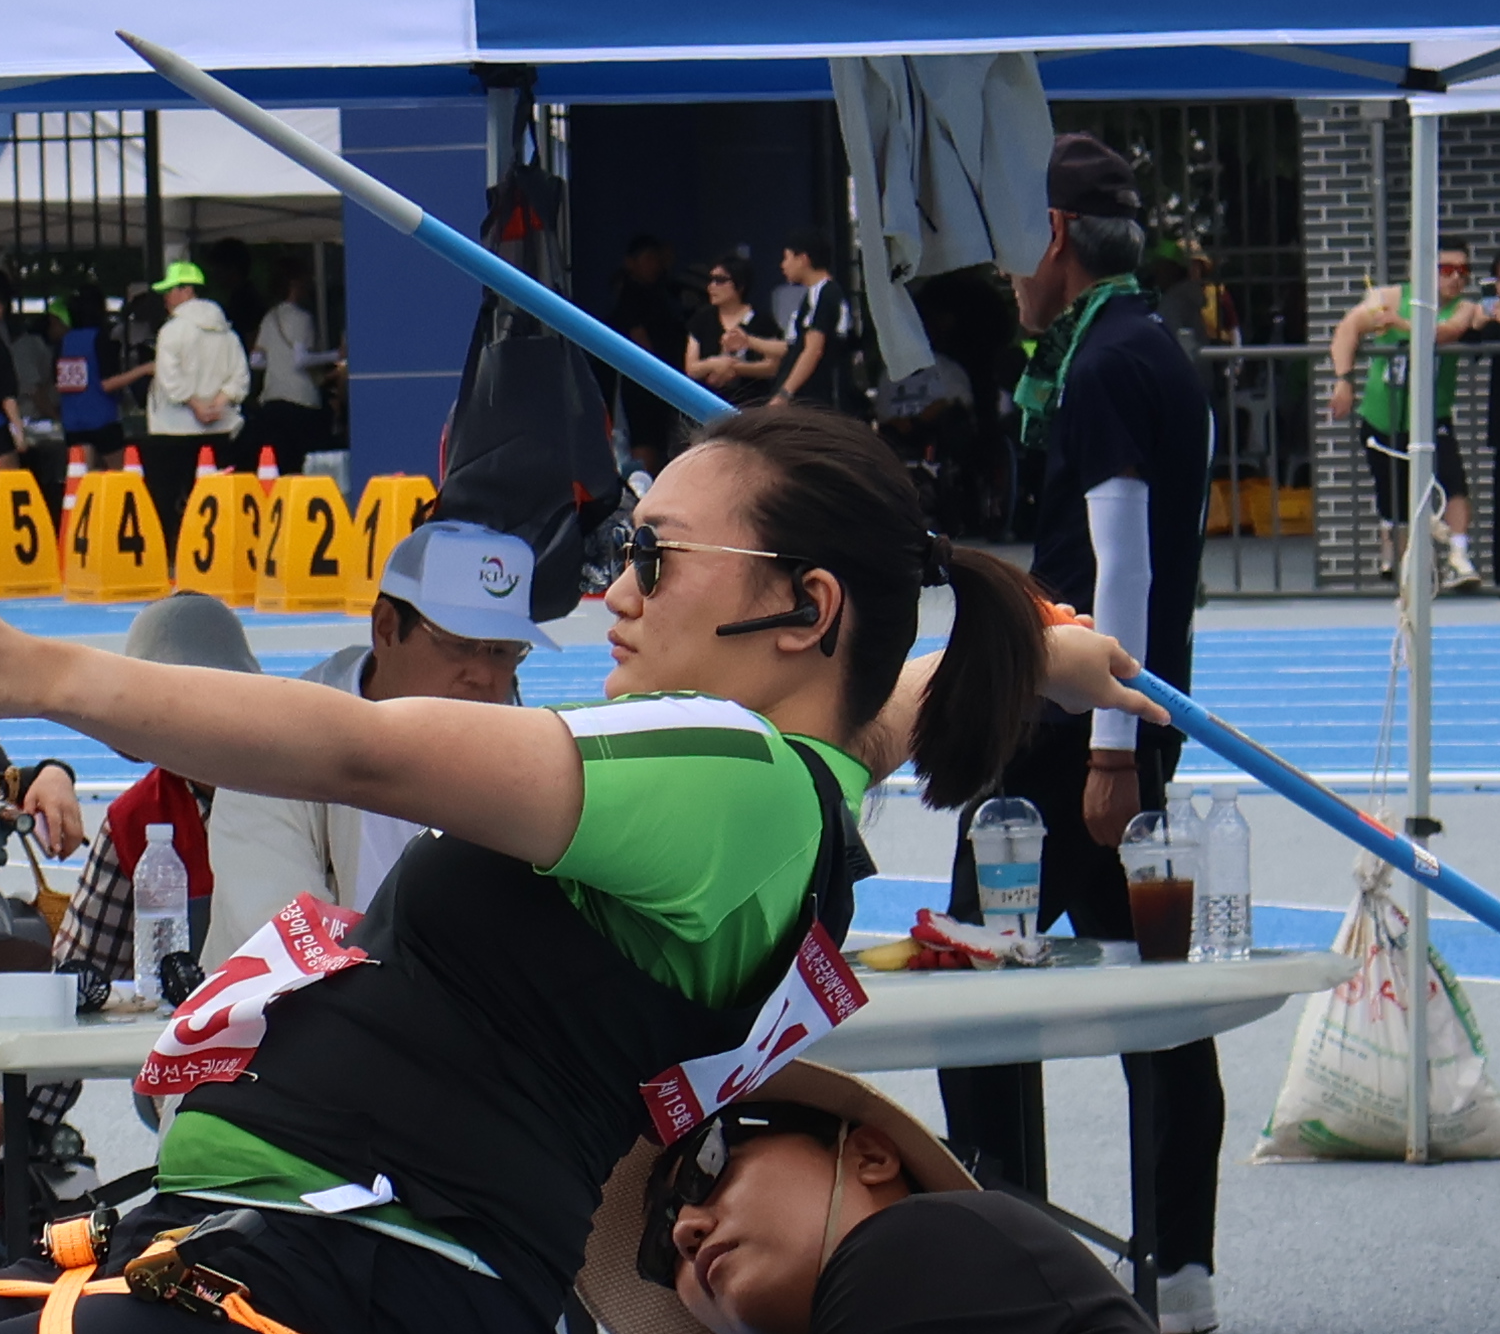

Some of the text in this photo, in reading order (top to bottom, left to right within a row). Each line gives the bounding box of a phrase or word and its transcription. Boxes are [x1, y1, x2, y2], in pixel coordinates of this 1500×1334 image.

[11, 489, 39, 565] 5
[73, 492, 94, 569] 4
[117, 491, 145, 567] 4
[192, 495, 219, 573] 3
[307, 496, 340, 577] 2
[363, 498, 382, 581] 1
